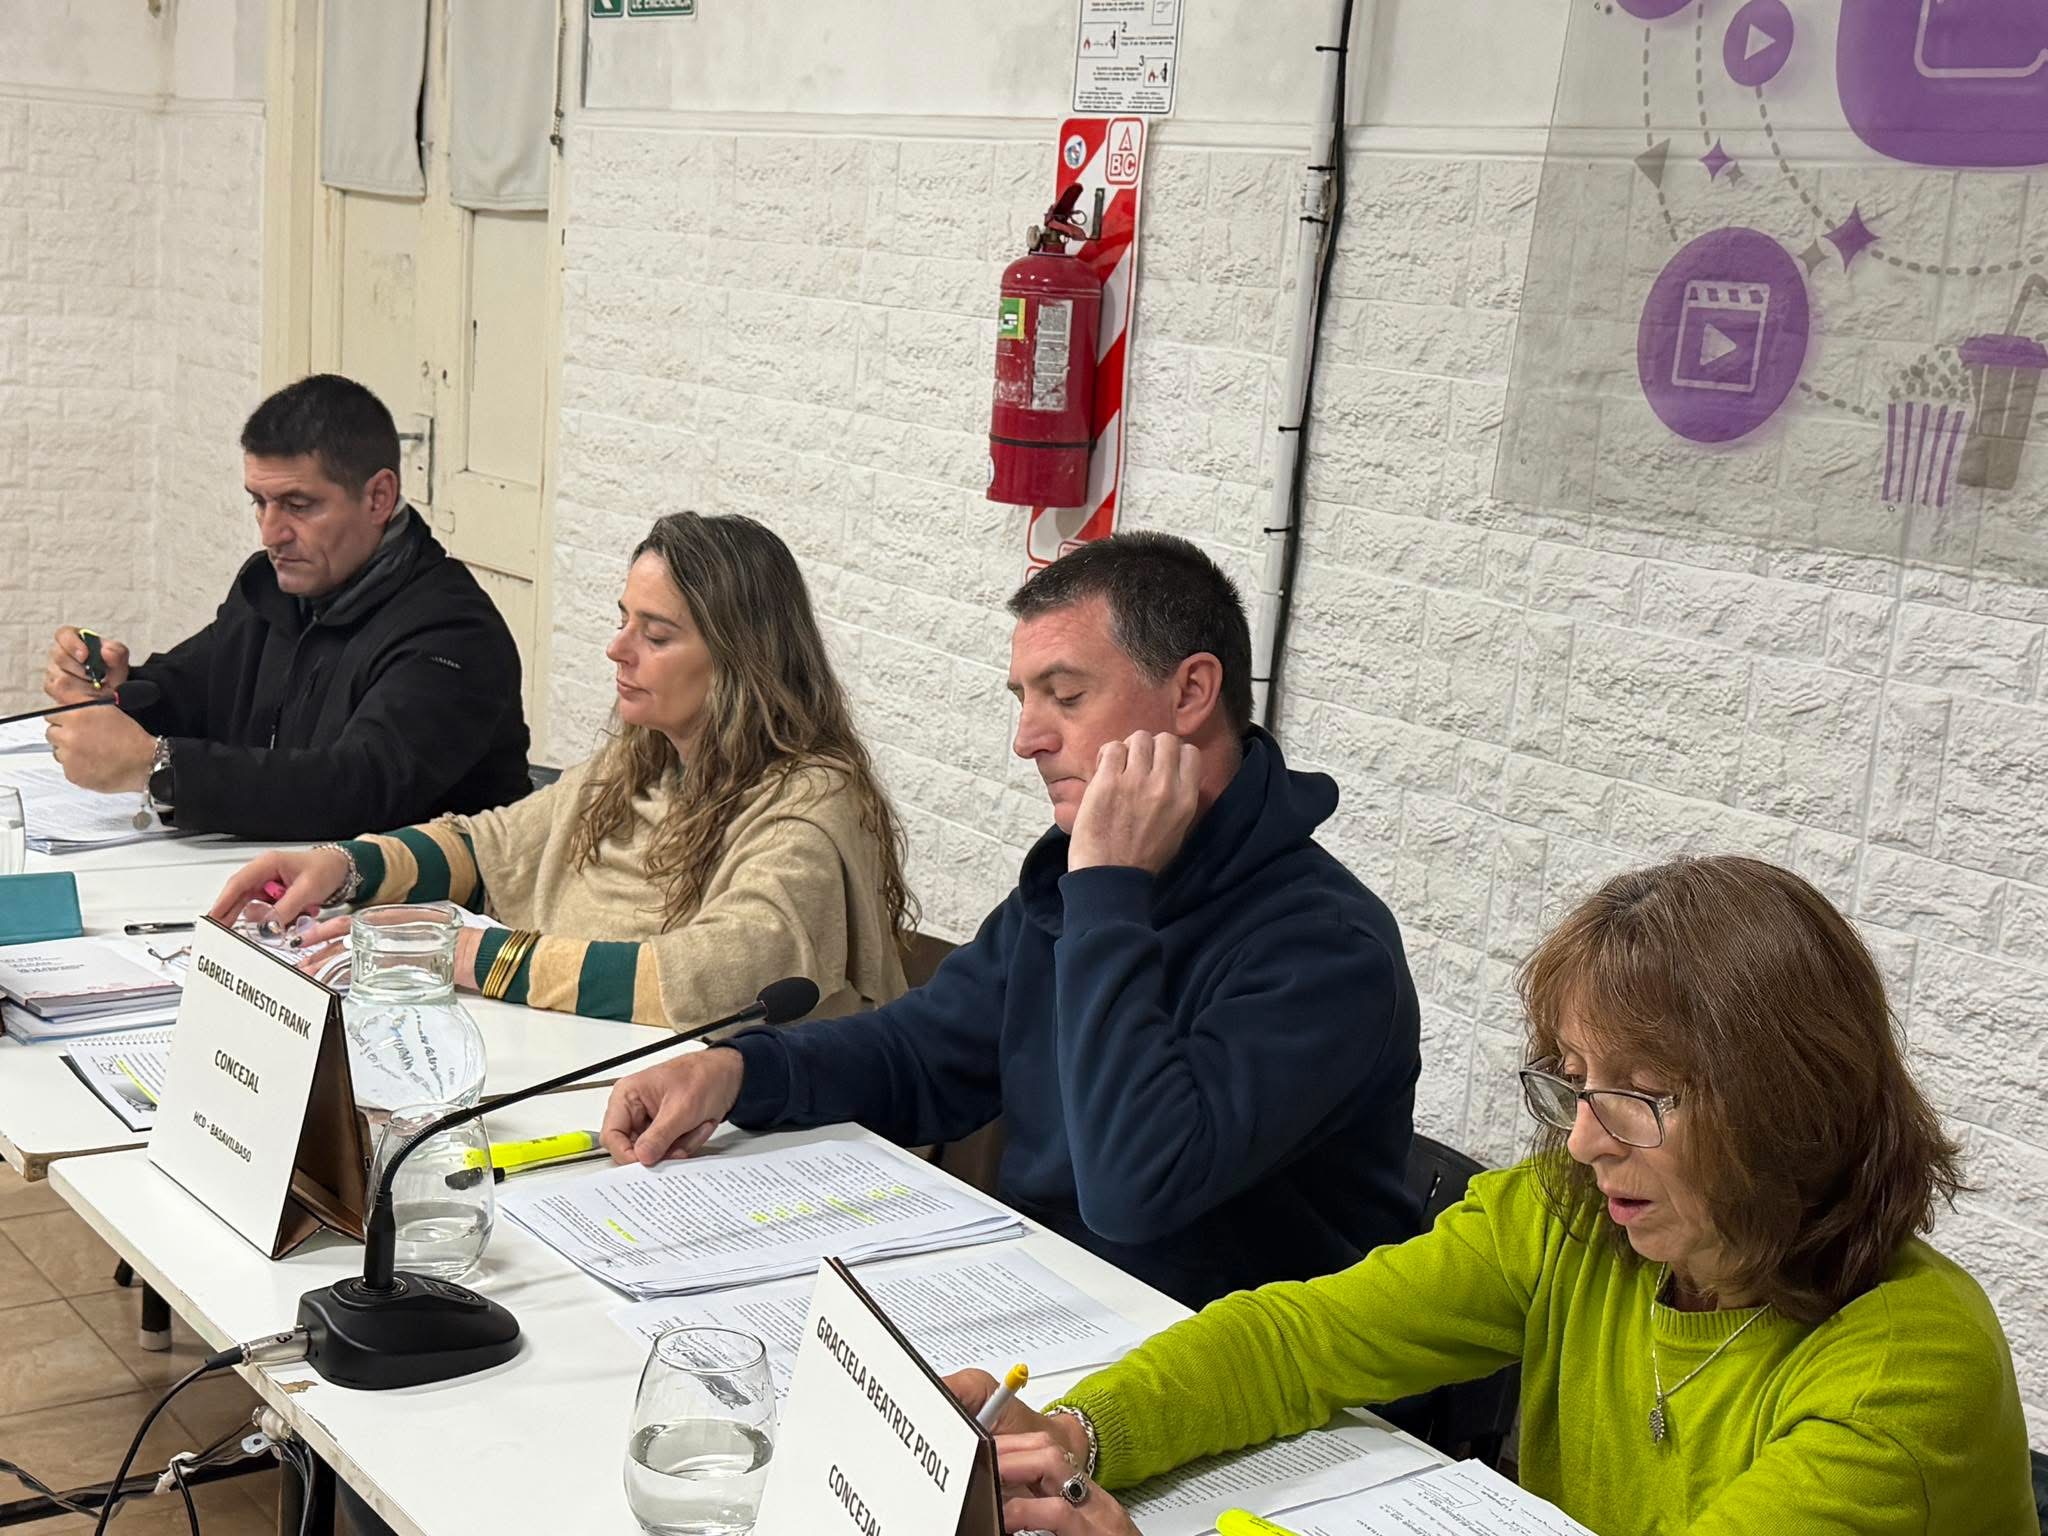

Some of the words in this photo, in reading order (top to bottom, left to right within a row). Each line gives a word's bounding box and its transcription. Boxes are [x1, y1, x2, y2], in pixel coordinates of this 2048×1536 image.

[1121, 21, 1128, 33] 2
[1118, 126, 1133, 151] A
[1110, 153, 1137, 177] BC
[197, 955, 235, 992] GABRIEL
[236, 978, 278, 1018] ERNESTO
[278, 1005, 312, 1040] FRANK
[214, 1049, 260, 1094] CONCEJAL
[193, 1110, 207, 1129] HCD
[209, 1123, 252, 1163] BASAVILBASO
[816, 1315, 868, 1392] GRACIELA
[866, 1376, 916, 1450] BEATRIZ
[913, 1433, 950, 1493] PIOLI
